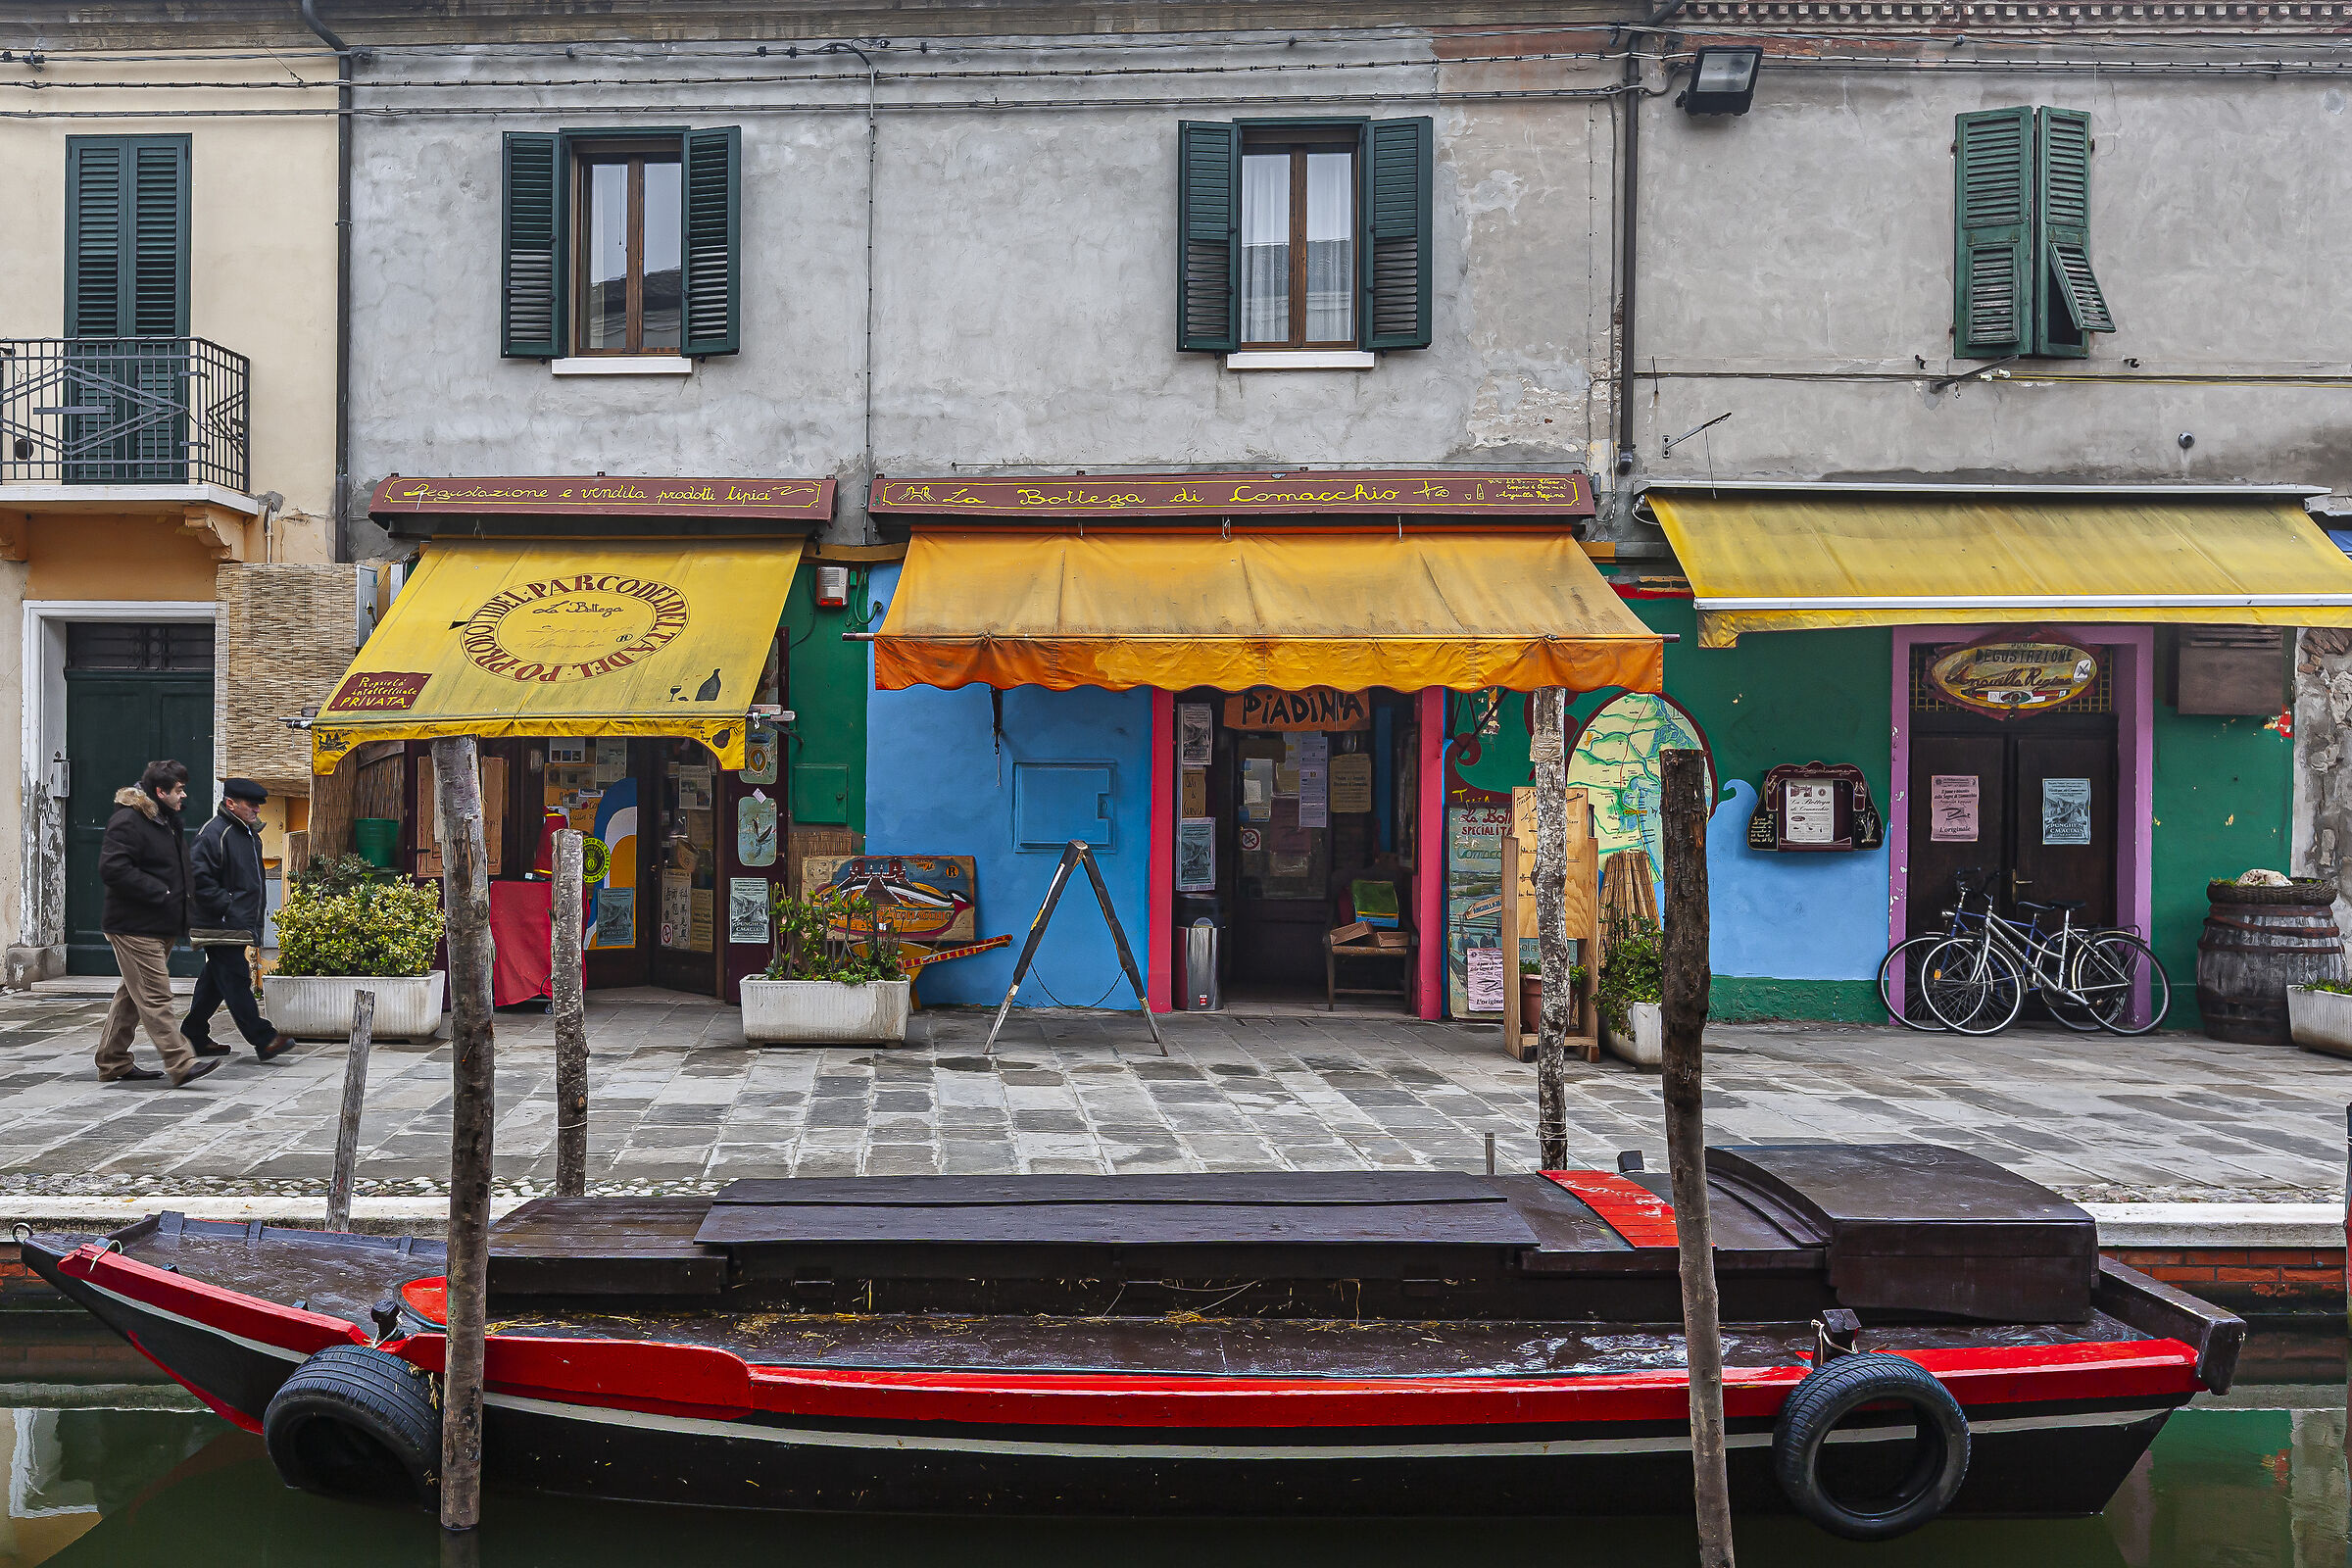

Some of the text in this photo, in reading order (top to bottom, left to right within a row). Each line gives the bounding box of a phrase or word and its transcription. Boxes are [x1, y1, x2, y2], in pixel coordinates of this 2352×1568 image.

[580, 483, 649, 500] vendita
[656, 484, 716, 504] prodotti
[723, 484, 773, 504] tipici
[943, 483, 1401, 509] La Bottega di Comacchio
[526, 575, 641, 598] PARCO
[1975, 648, 2074, 663] DEGUSTAZIONE
[339, 695, 406, 708] PRIVATA
